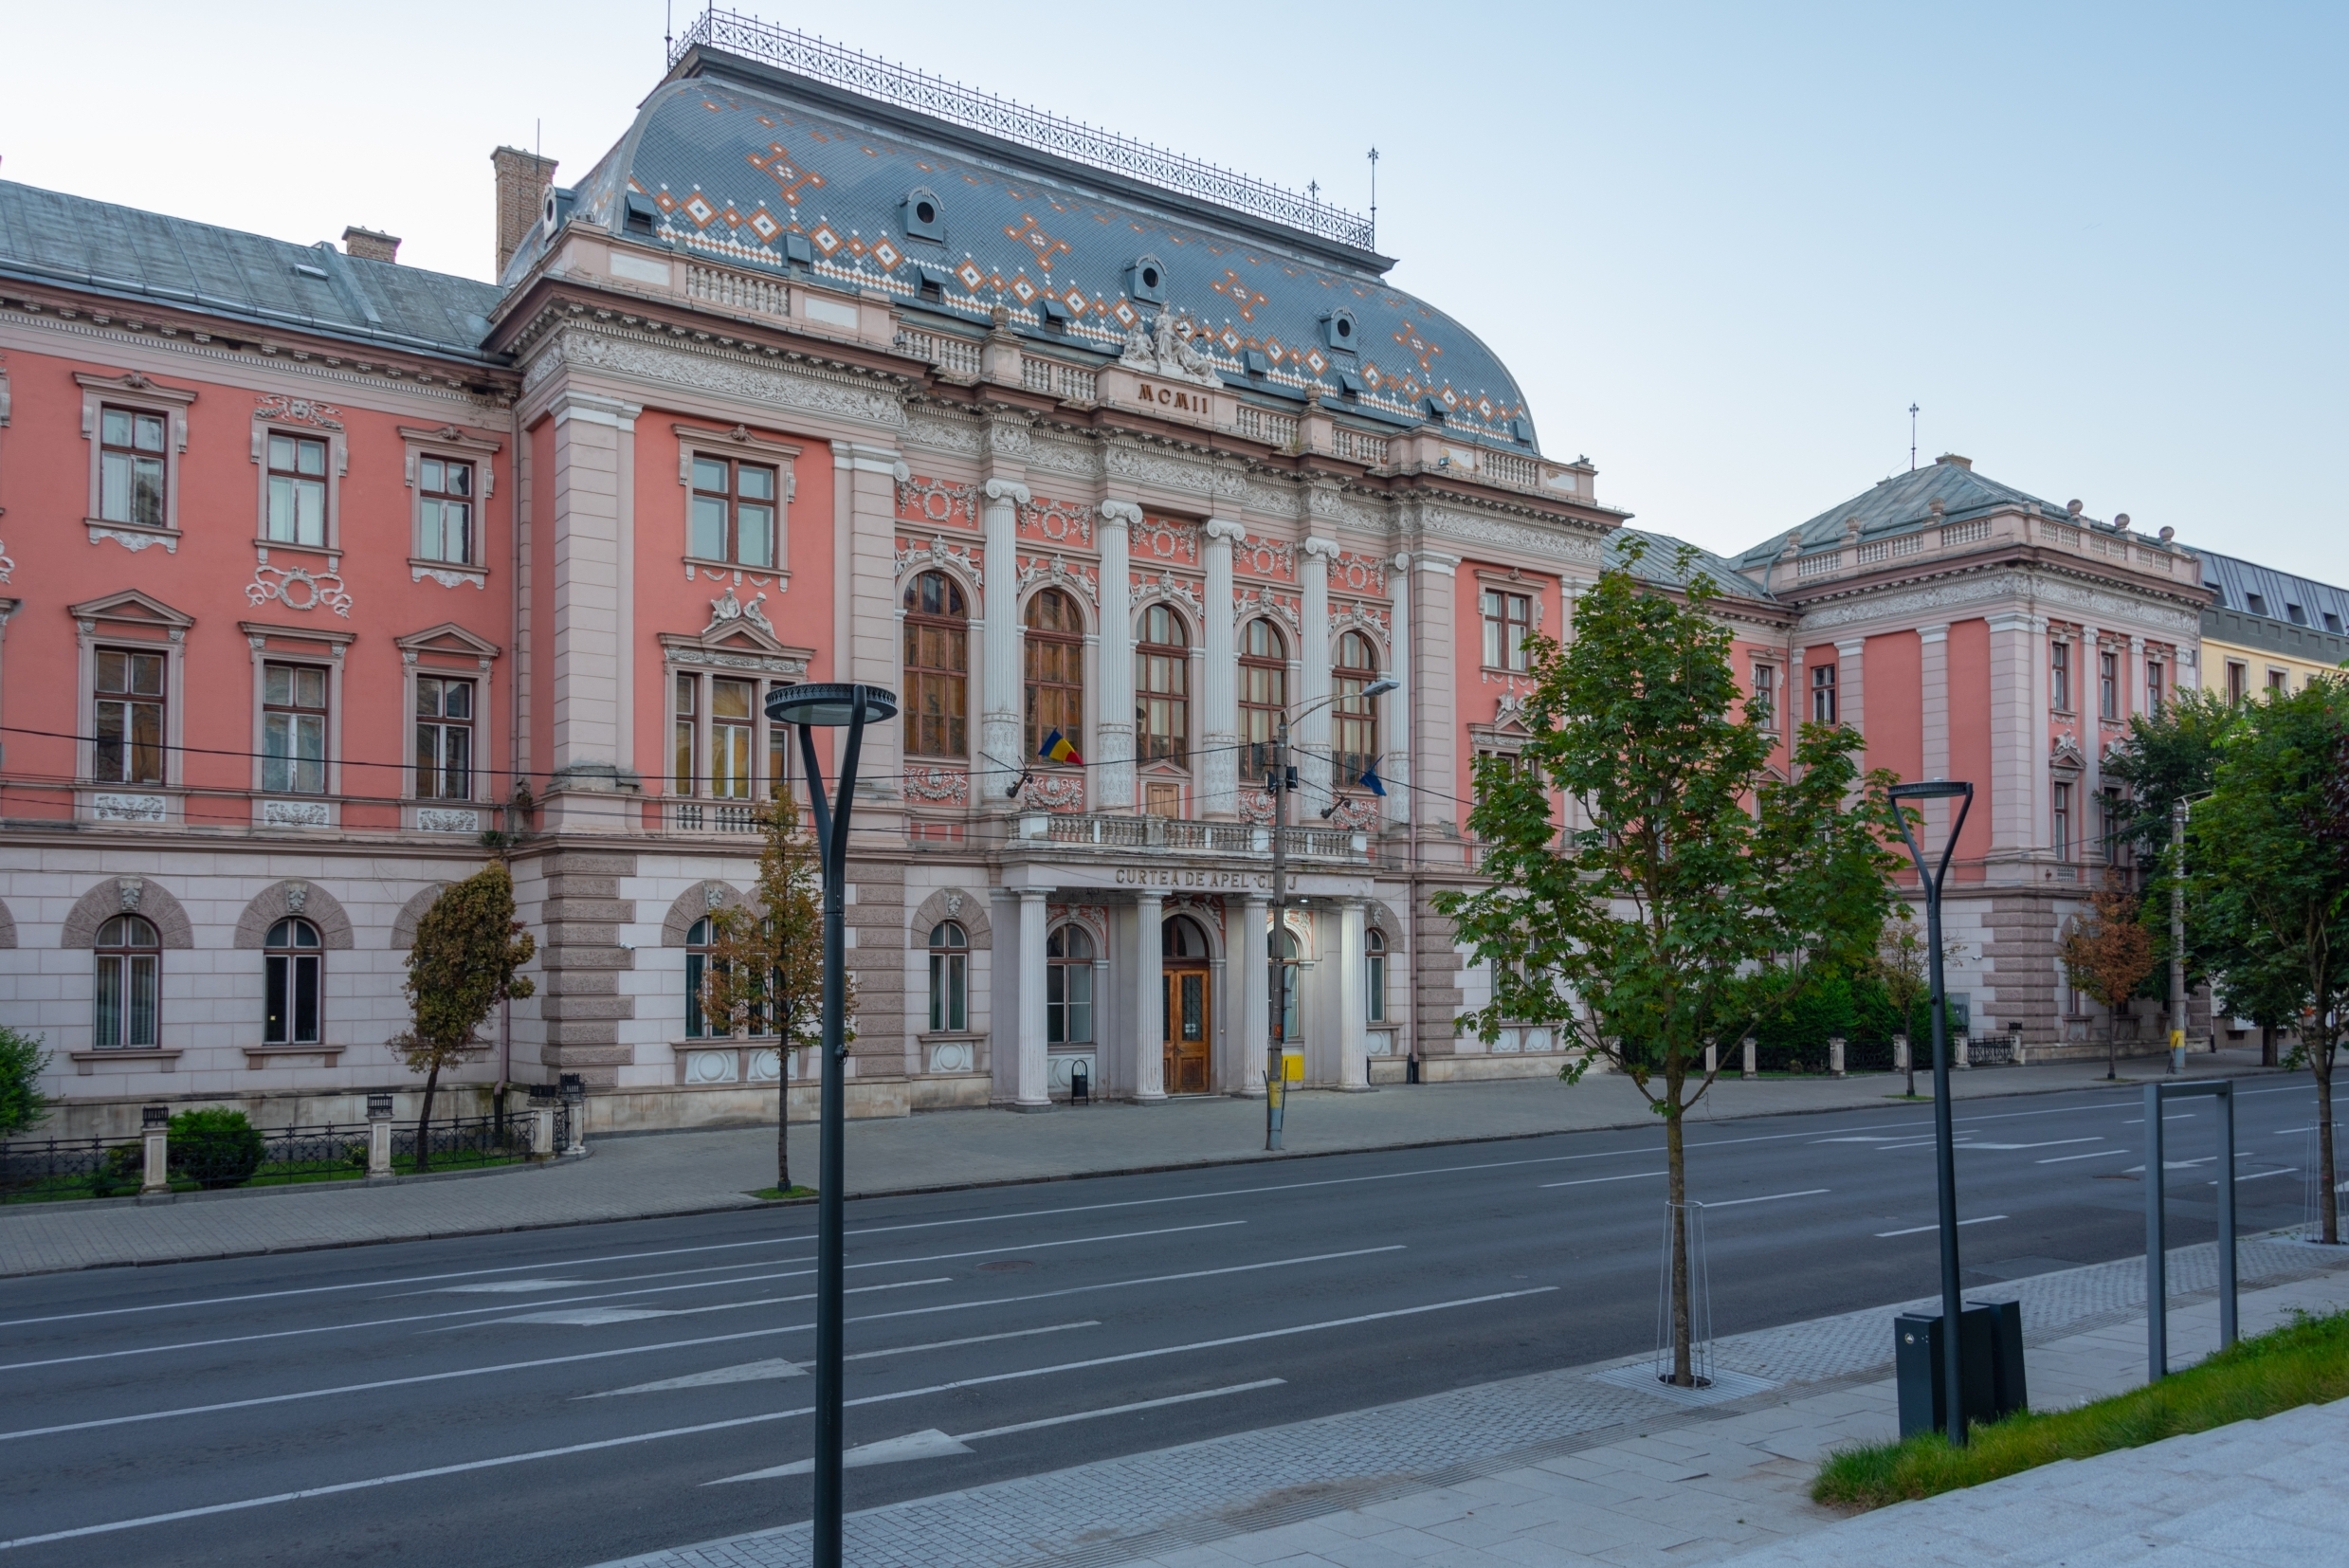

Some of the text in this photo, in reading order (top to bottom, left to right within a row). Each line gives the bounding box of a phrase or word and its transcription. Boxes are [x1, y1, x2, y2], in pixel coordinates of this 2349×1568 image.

[1138, 384, 1208, 413] MCMII
[1116, 868, 1297, 890] CURTEA DE APEL CLJ
